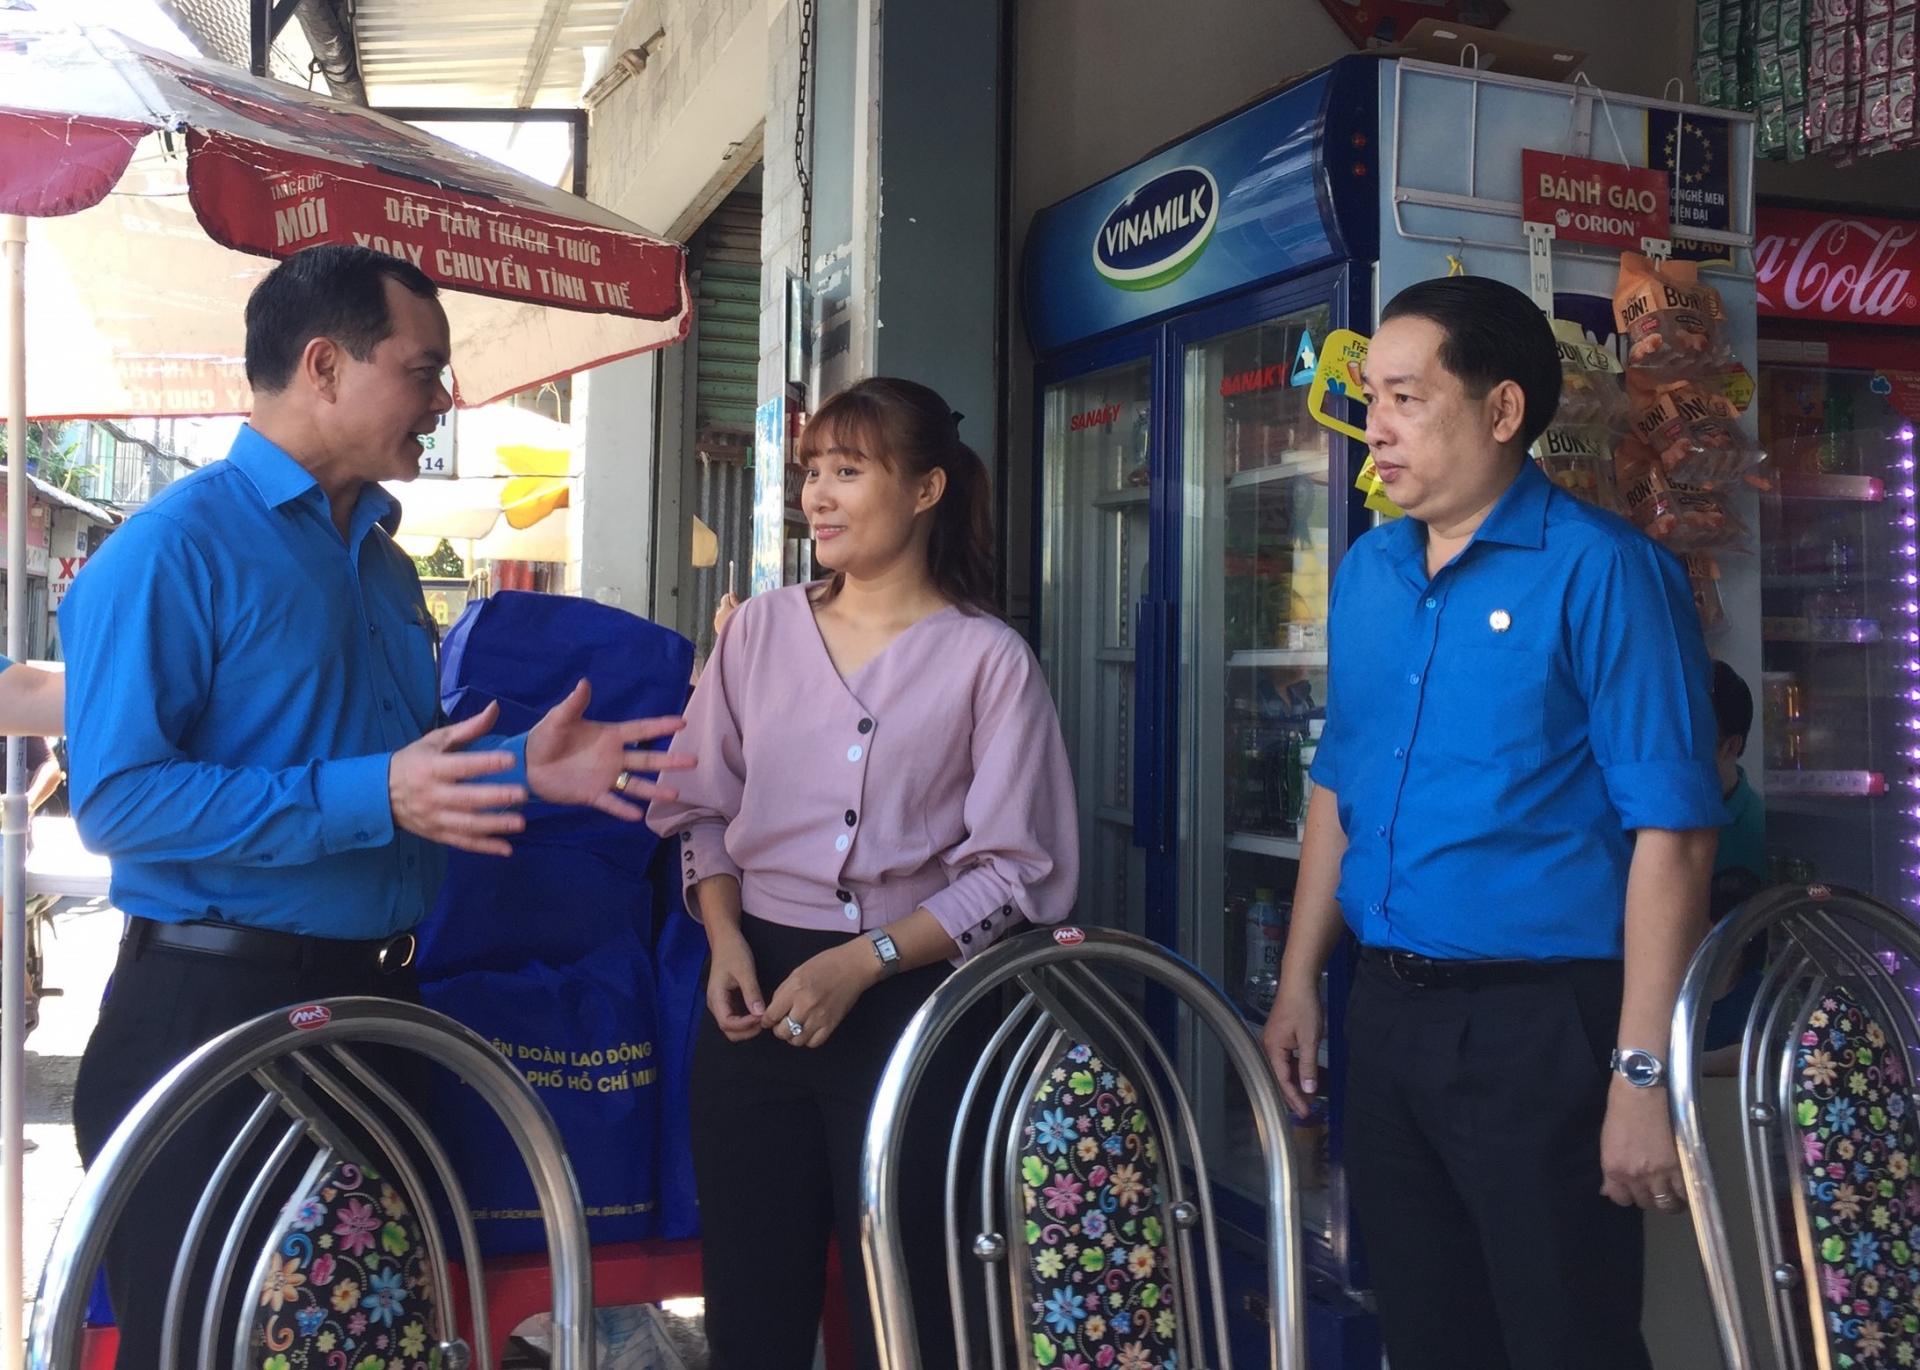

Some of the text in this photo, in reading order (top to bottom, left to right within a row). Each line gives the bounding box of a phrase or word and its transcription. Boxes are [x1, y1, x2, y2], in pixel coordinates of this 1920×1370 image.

[1539, 170, 1657, 216] BÁNH GẠO
[1704, 192, 1725, 206] MEN
[275, 196, 329, 247] MỚI
[1106, 184, 1206, 257] VINAMILK
[1574, 213, 1635, 237] ORION
[1692, 208, 1709, 224] ĐẠI
[384, 196, 602, 267] ĐẬP TAN THÁCH THỨC
[436, 249, 532, 291] CHUYỂN
[536, 267, 588, 302] TÌNH
[591, 281, 634, 310] THẾ
[1220, 363, 1288, 397] SANAKY
[1070, 404, 1121, 431] SANAKY
[518, 1045, 567, 1065] ĐOÀN
[570, 1050, 604, 1067] LAO
[606, 1041, 652, 1066] ĐỘNG
[526, 1069, 563, 1088] PHỐ
[567, 1072, 593, 1092] HỒ
[597, 1070, 630, 1093] CHÍ
